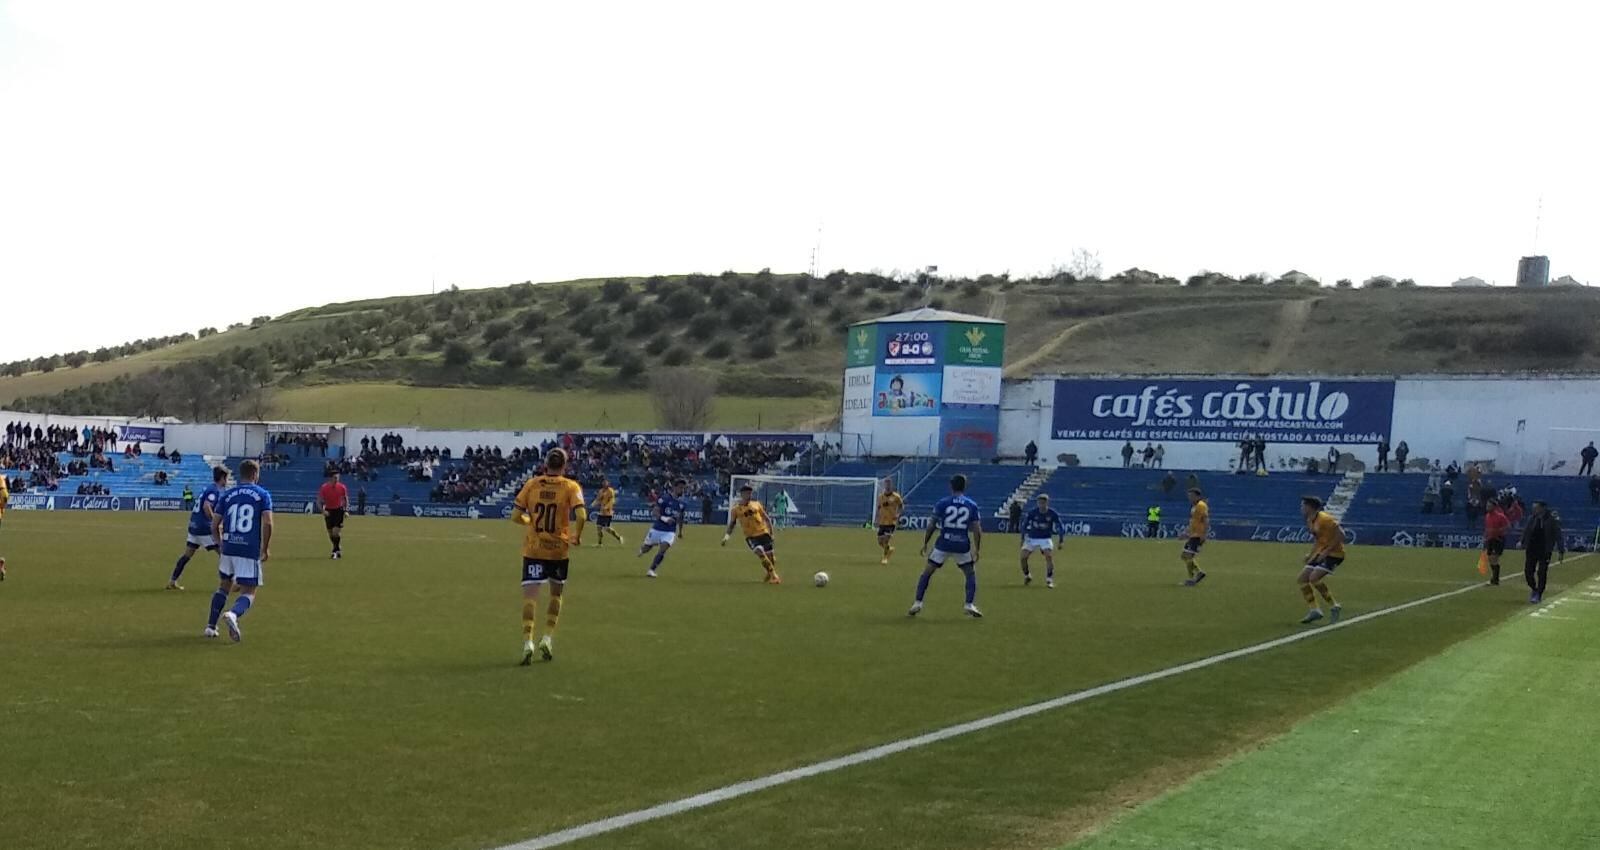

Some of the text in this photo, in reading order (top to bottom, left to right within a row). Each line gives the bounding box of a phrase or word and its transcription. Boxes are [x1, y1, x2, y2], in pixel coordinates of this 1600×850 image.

[895, 332, 929, 341] 27:00
[848, 374, 871, 387] IDEAL
[844, 398, 868, 410] IDEAL
[1092, 385, 1193, 426] cafés
[1158, 417, 1178, 426] CAFÉ
[1180, 419, 1190, 427] DE
[1192, 419, 1227, 427] LINARES
[1057, 428, 1384, 442] VENTA DE CAFÉS DE ESPECIALIDAD RECIÉN TOSTADO A TODA ESPAÑA
[227, 503, 254, 533] 18
[534, 503, 557, 533] 20
[944, 505, 969, 529] 22
[1250, 525, 1271, 540] La
